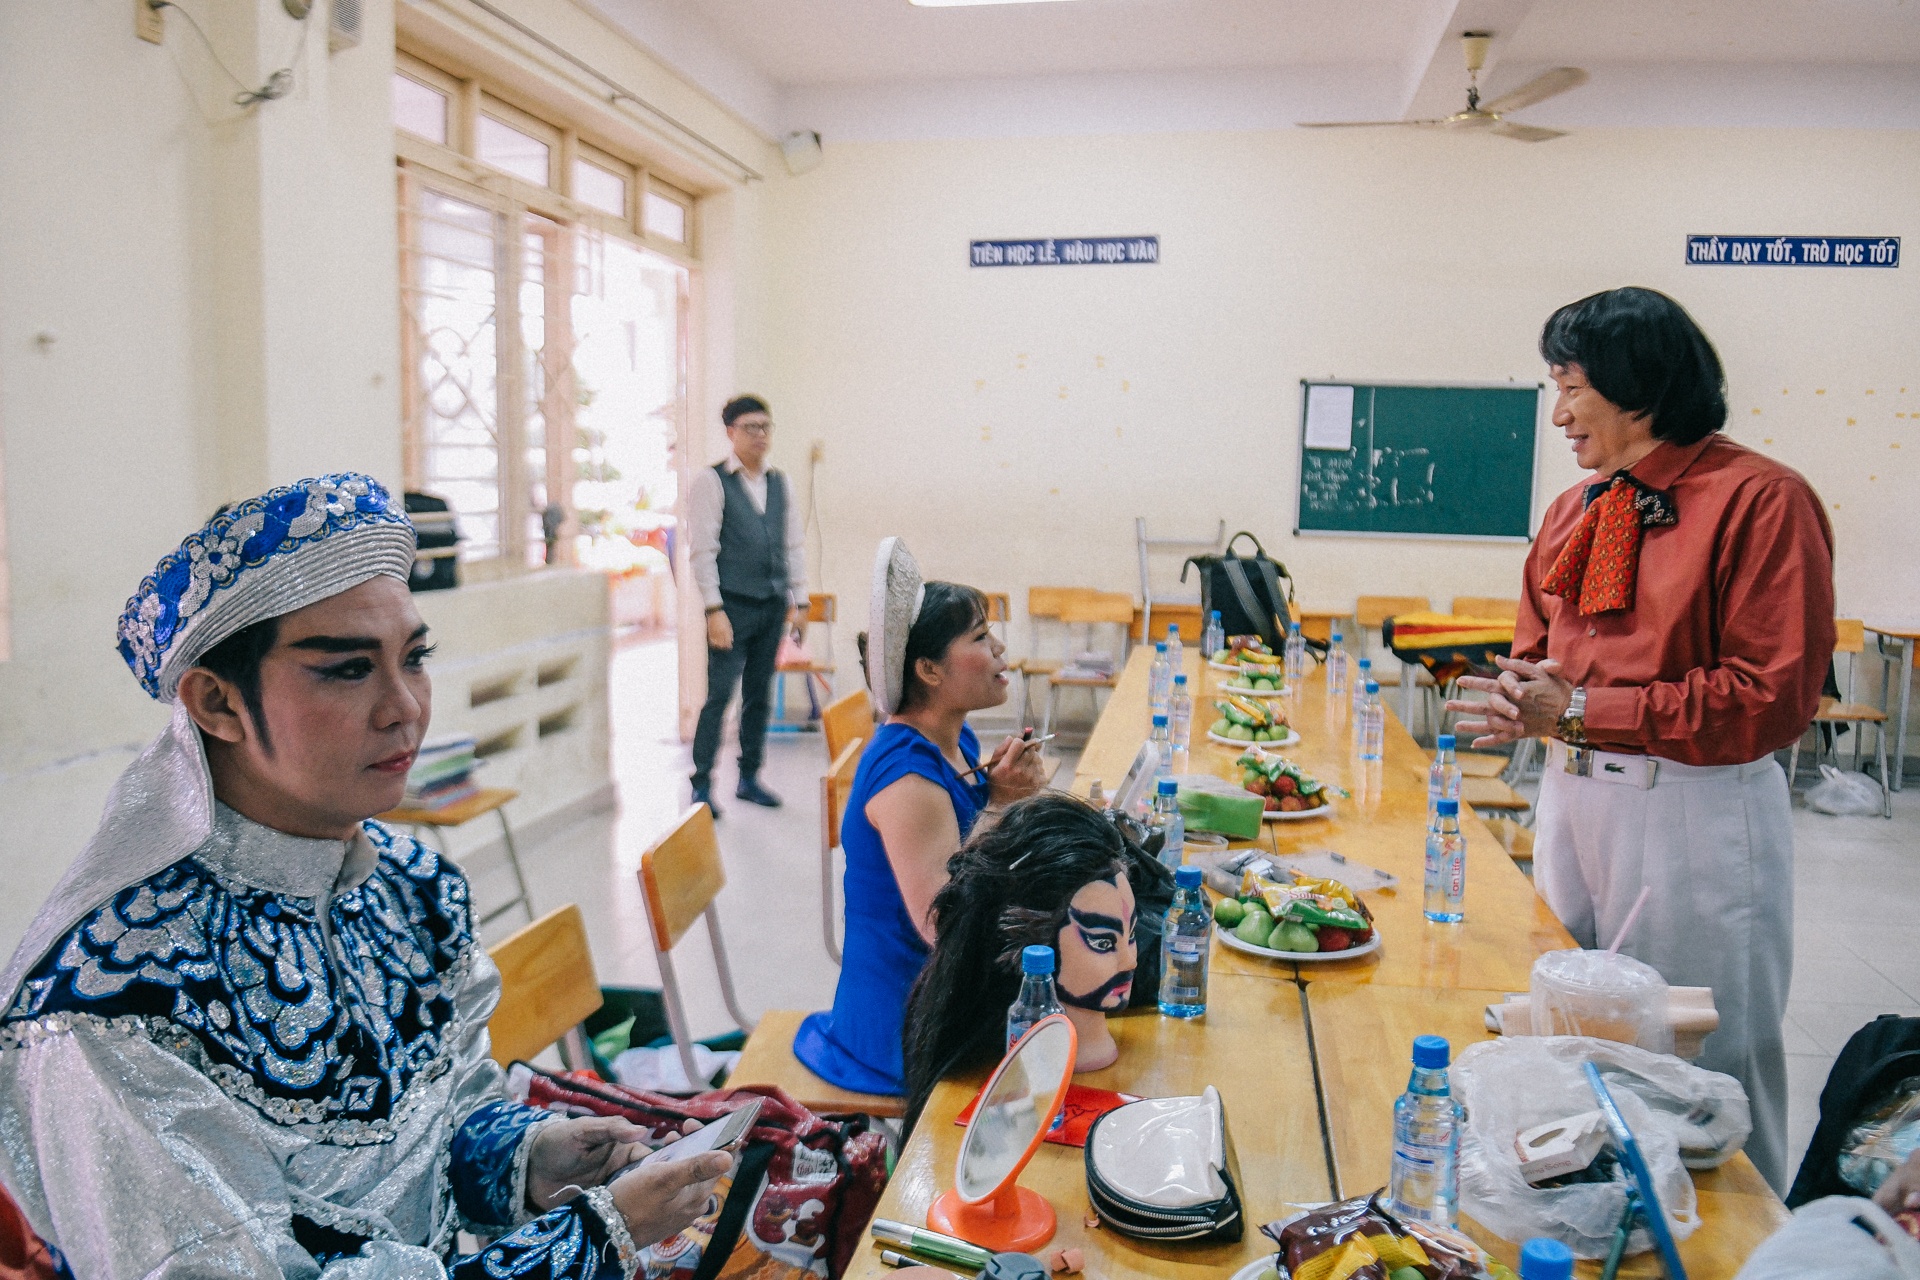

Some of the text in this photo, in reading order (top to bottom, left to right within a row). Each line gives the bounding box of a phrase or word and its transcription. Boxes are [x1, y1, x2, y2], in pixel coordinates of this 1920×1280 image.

[973, 242, 1003, 264] TIÊN
[1006, 244, 1034, 264] HỌC
[1065, 240, 1093, 264] HẬU
[1097, 242, 1125, 263] HỌC
[1129, 239, 1157, 261] VĂN
[1691, 236, 1896, 265] THẦY DẠY TỐT, TRÒ HỌC TỐT
